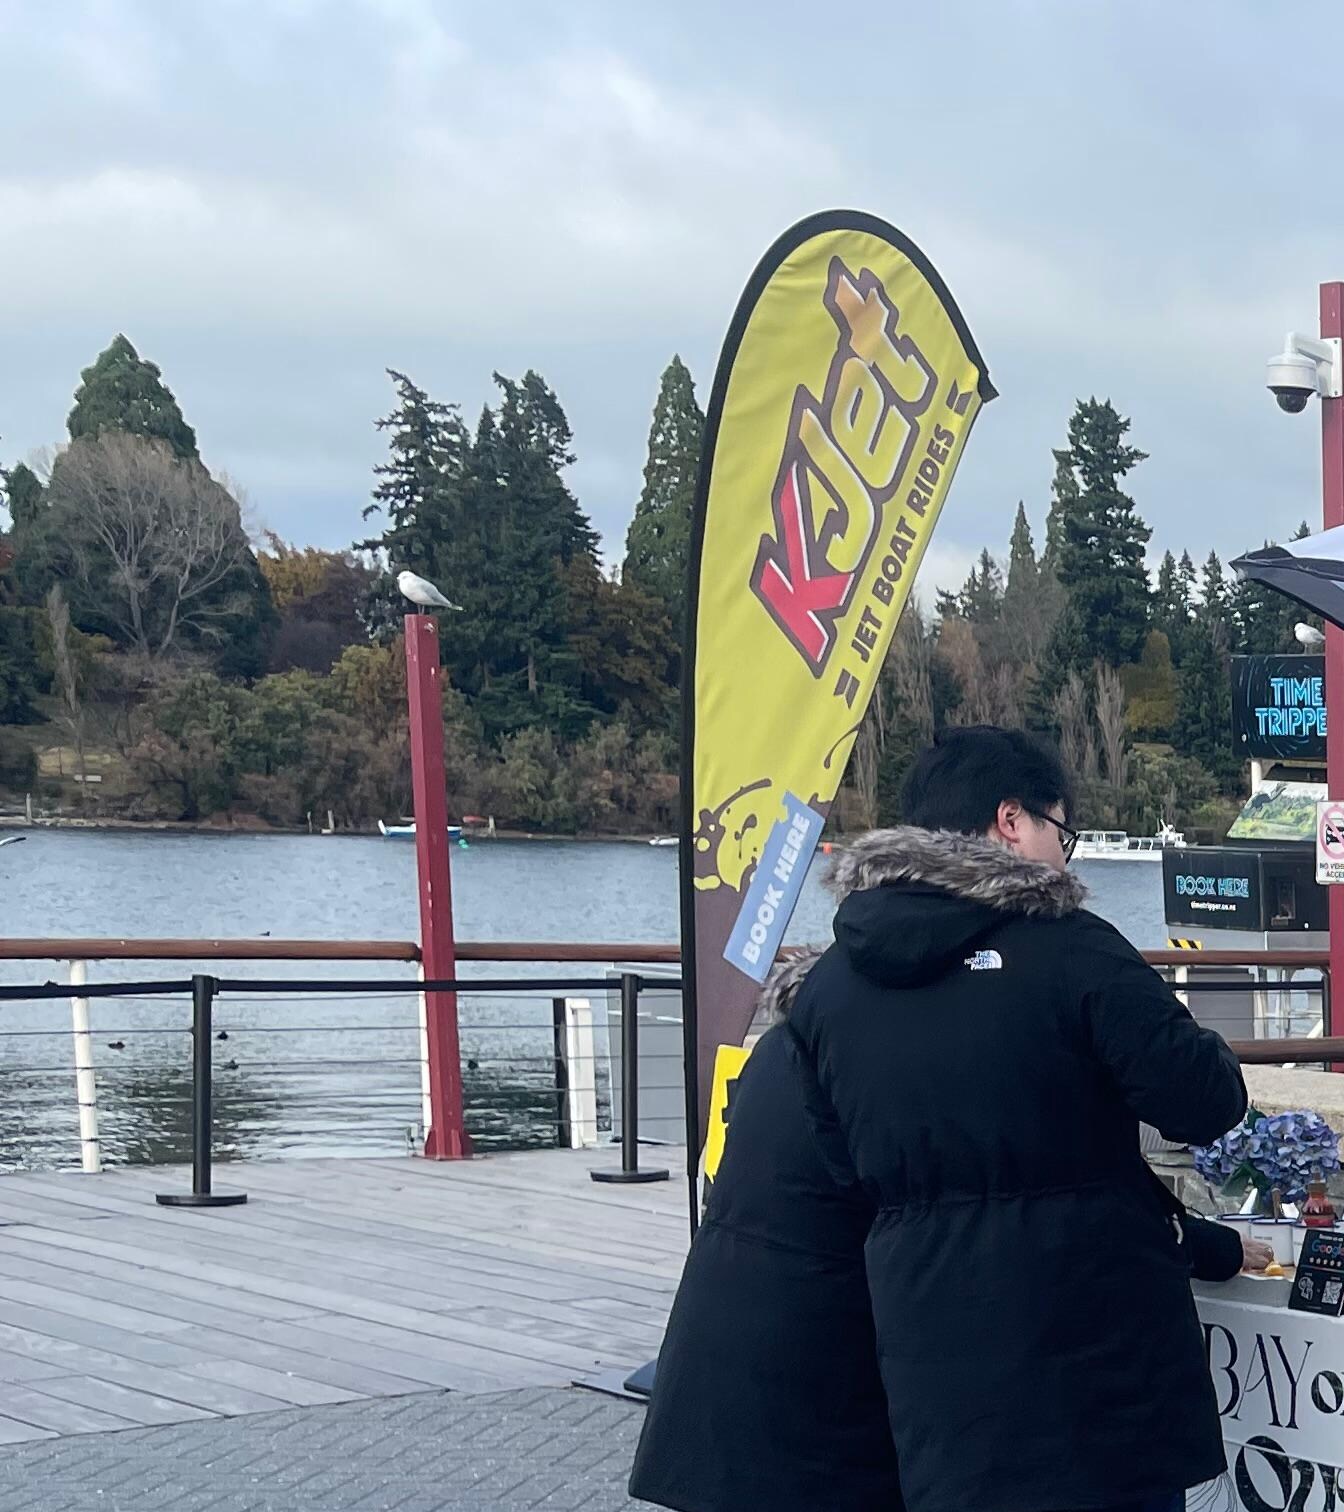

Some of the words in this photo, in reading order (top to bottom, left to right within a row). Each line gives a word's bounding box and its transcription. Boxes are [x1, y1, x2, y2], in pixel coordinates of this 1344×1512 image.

[851, 605, 882, 663] JET
[872, 516, 916, 606] BOAT
[907, 424, 955, 517] RIDES
[1255, 708, 1327, 736] TRIPPE
[1271, 677, 1323, 706] TIME
[742, 884, 783, 965] BOOK
[774, 812, 810, 883] HERE
[1176, 875, 1215, 895] BOOK
[1217, 878, 1249, 898] HERE
[1203, 1323, 1313, 1430] BAY
